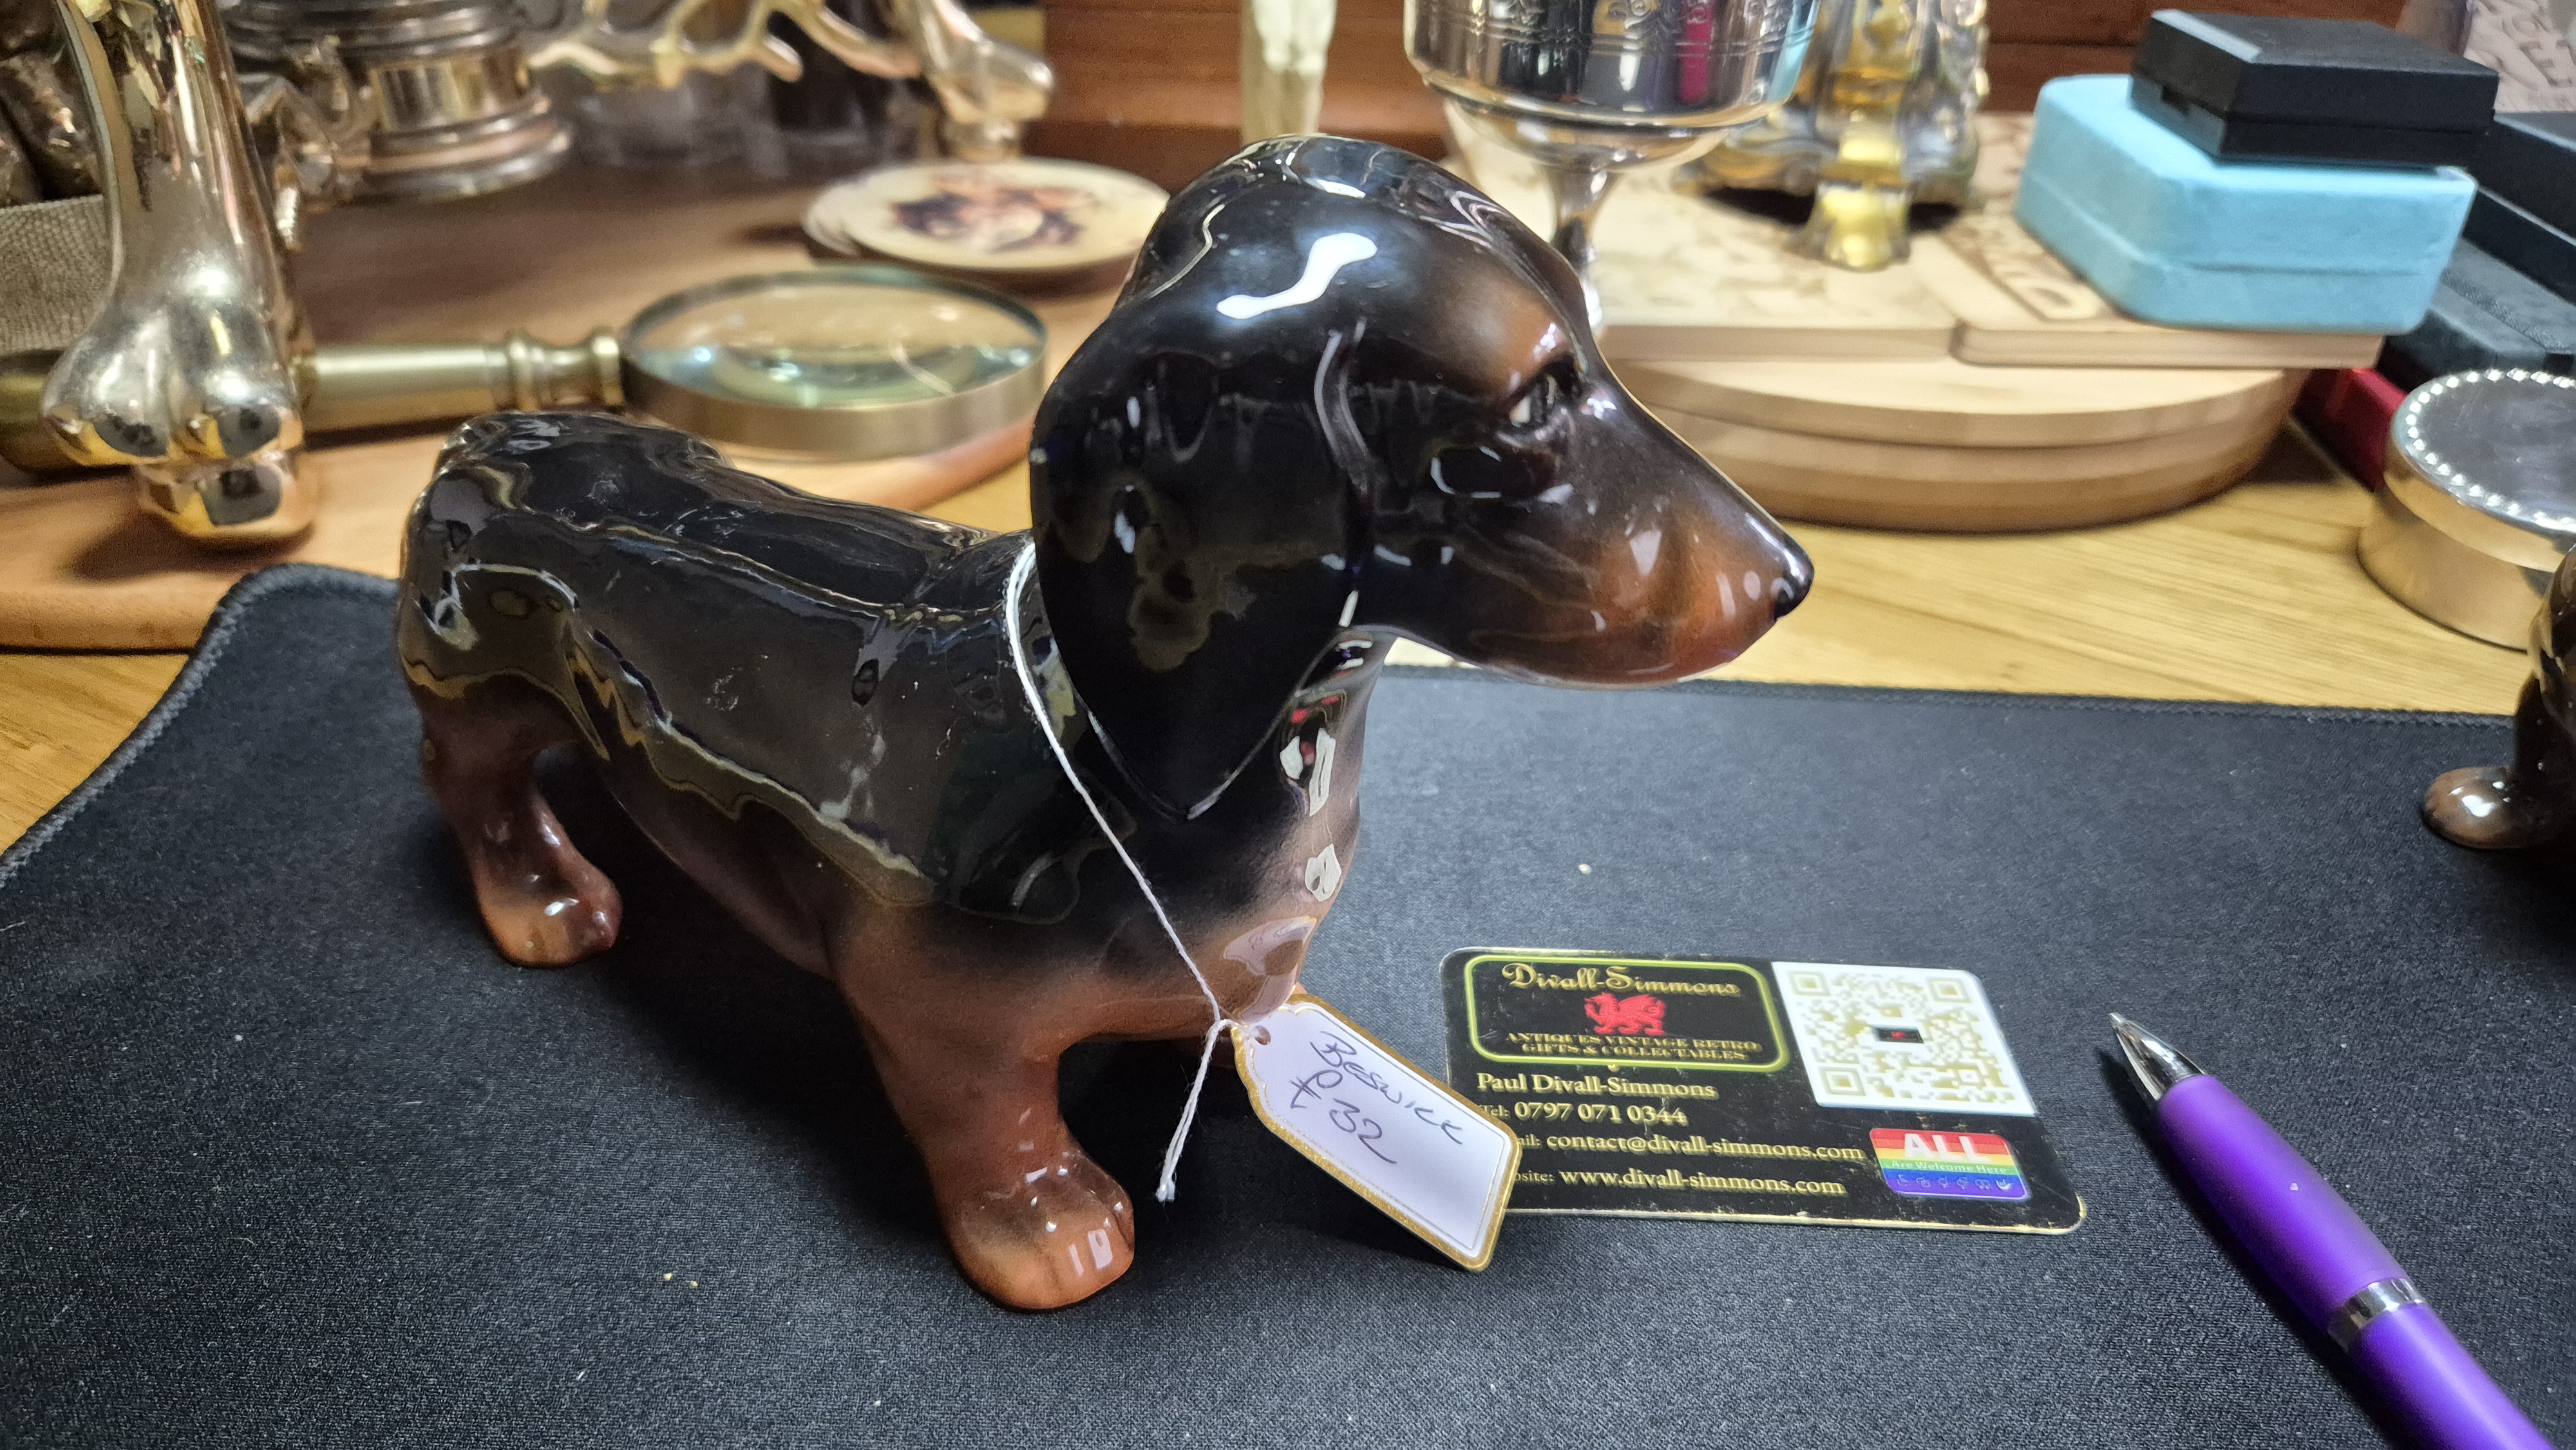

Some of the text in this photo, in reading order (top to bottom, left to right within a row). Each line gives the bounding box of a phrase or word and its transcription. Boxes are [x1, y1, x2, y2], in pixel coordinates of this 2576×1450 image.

[1502, 963, 1740, 996] Divall-Simmons
[1506, 1032, 1763, 1053] ANTIQUES VINTAGE RETRO
[1522, 1042, 1750, 1062] GIFTS & COLLECTABLES
[1477, 1072, 1719, 1100] Paul Divall-Simmons
[1479, 1101, 1690, 1127] Tel: 0797 071 0344
[1517, 1133, 1868, 1162] ail: contact@divall-simmons.com
[1903, 1133, 1991, 1163] ALL
[1891, 1160, 2007, 1174] Are Welcome Here
[1515, 1167, 1850, 1197] site: www.divall-simmons.com
